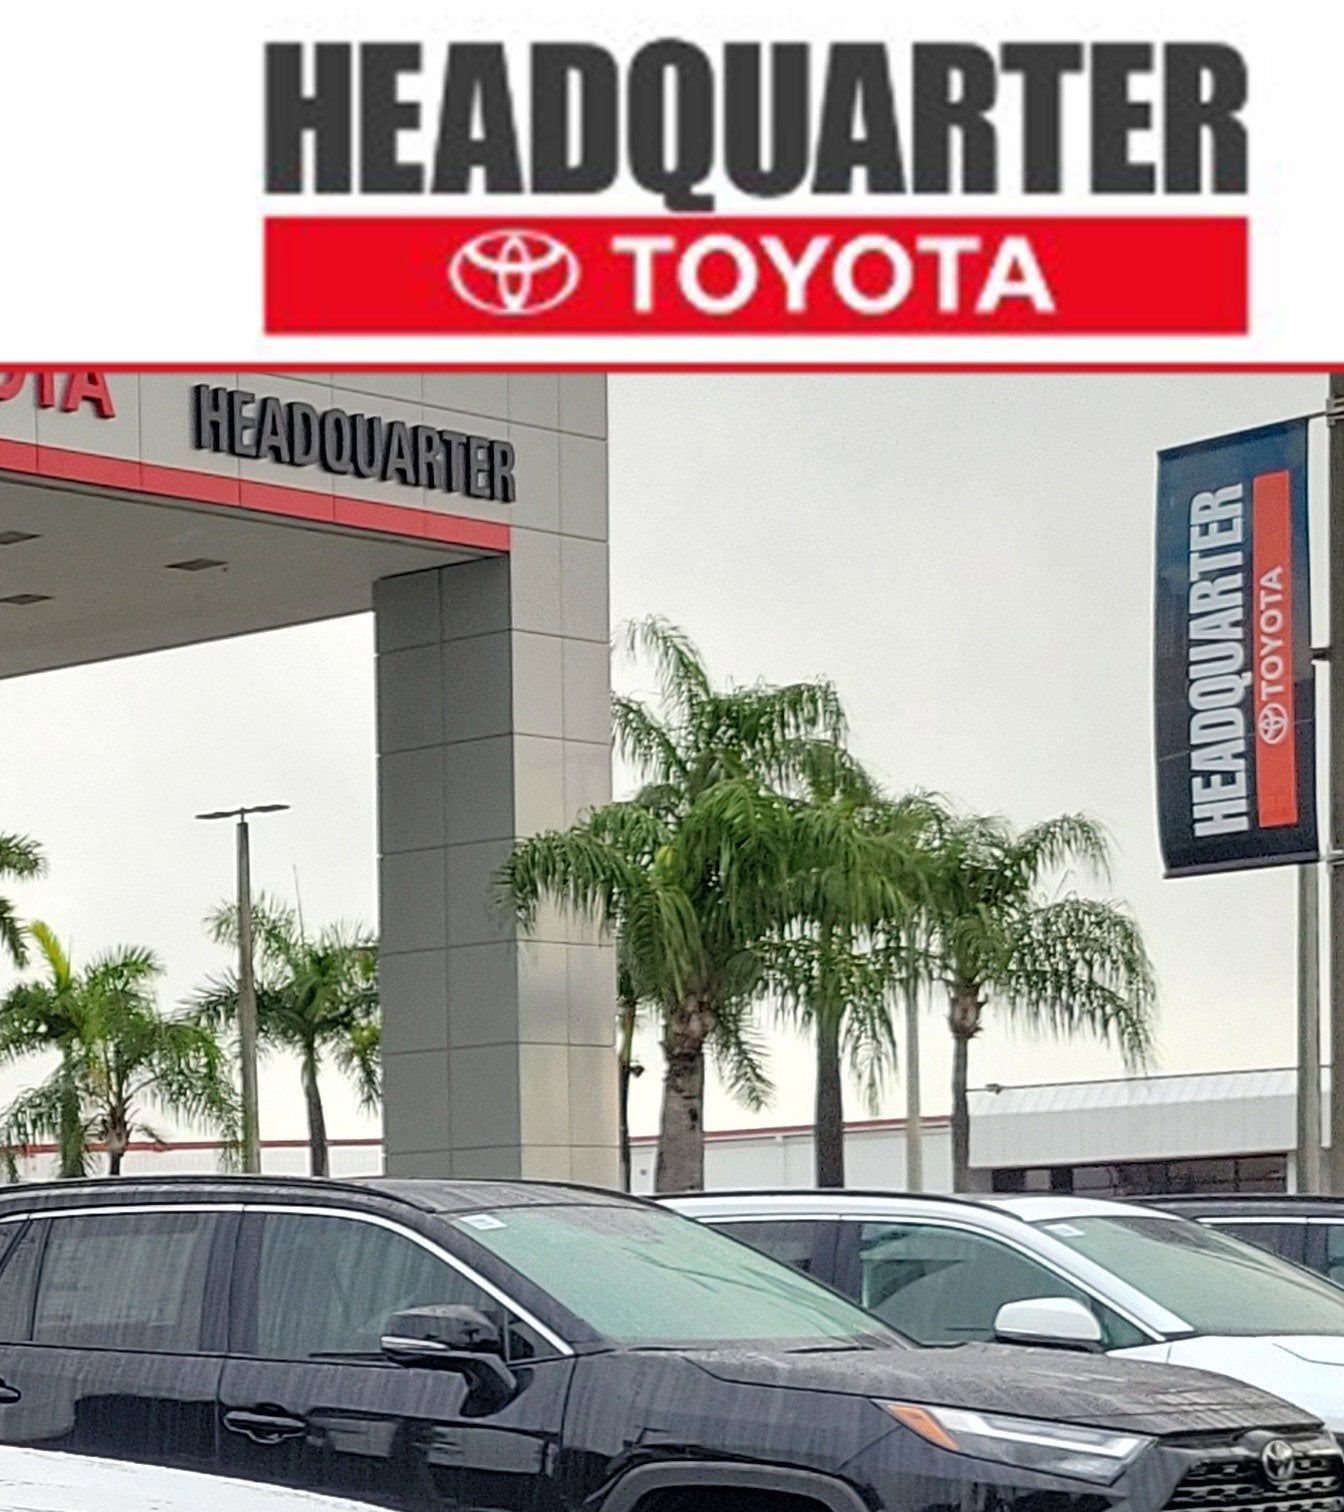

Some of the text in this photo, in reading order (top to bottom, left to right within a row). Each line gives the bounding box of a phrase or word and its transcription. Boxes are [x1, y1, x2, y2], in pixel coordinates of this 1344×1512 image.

[191, 383, 517, 503] HEADQUARTER
[1188, 482, 1253, 838] HEADQUARTER
[1258, 565, 1286, 701] TOYOTA
